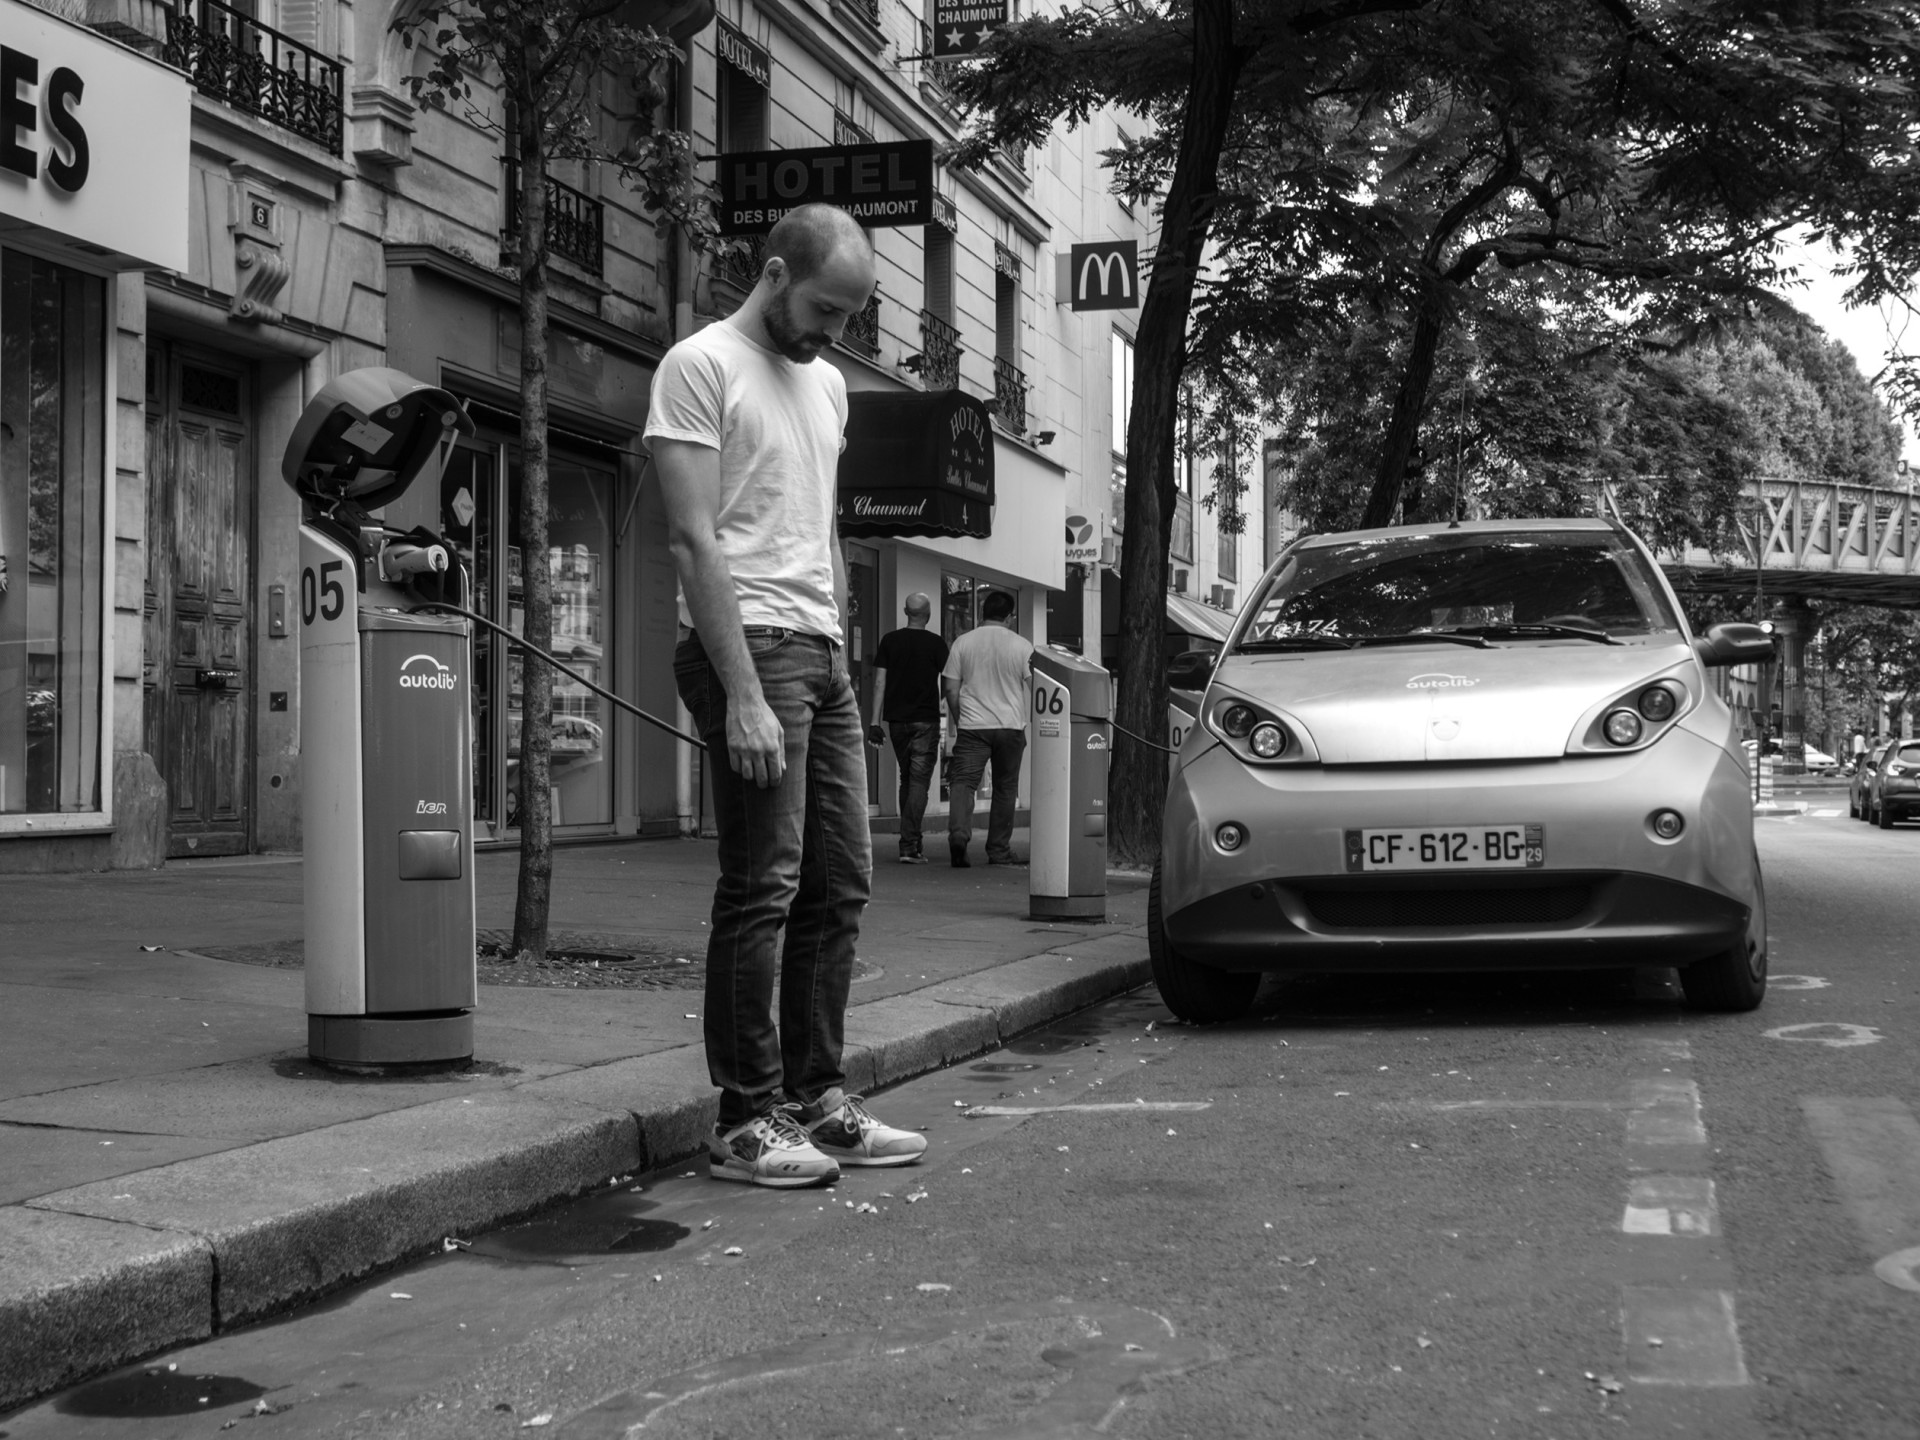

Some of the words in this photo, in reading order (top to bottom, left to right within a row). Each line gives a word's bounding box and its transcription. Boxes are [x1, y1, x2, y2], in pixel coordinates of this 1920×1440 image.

[938, 6, 1004, 24] CHAUMONT
[718, 25, 756, 75] HOTEL
[0, 44, 90, 193] ES
[734, 153, 917, 202] HOTEL
[257, 207, 265, 224] 6
[733, 209, 764, 224] DES
[840, 200, 919, 218] HAUMONT
[950, 406, 985, 453] HOTEL
[853, 495, 927, 516] Chaumont
[962, 503, 969, 525] 4
[1066, 548, 1097, 559] uygues
[301, 560, 344, 626] 05
[1035, 687, 1064, 715] 06
[1173, 726, 1191, 748] 0
[1352, 853, 1358, 863] F
[1527, 848, 1543, 862] 29
